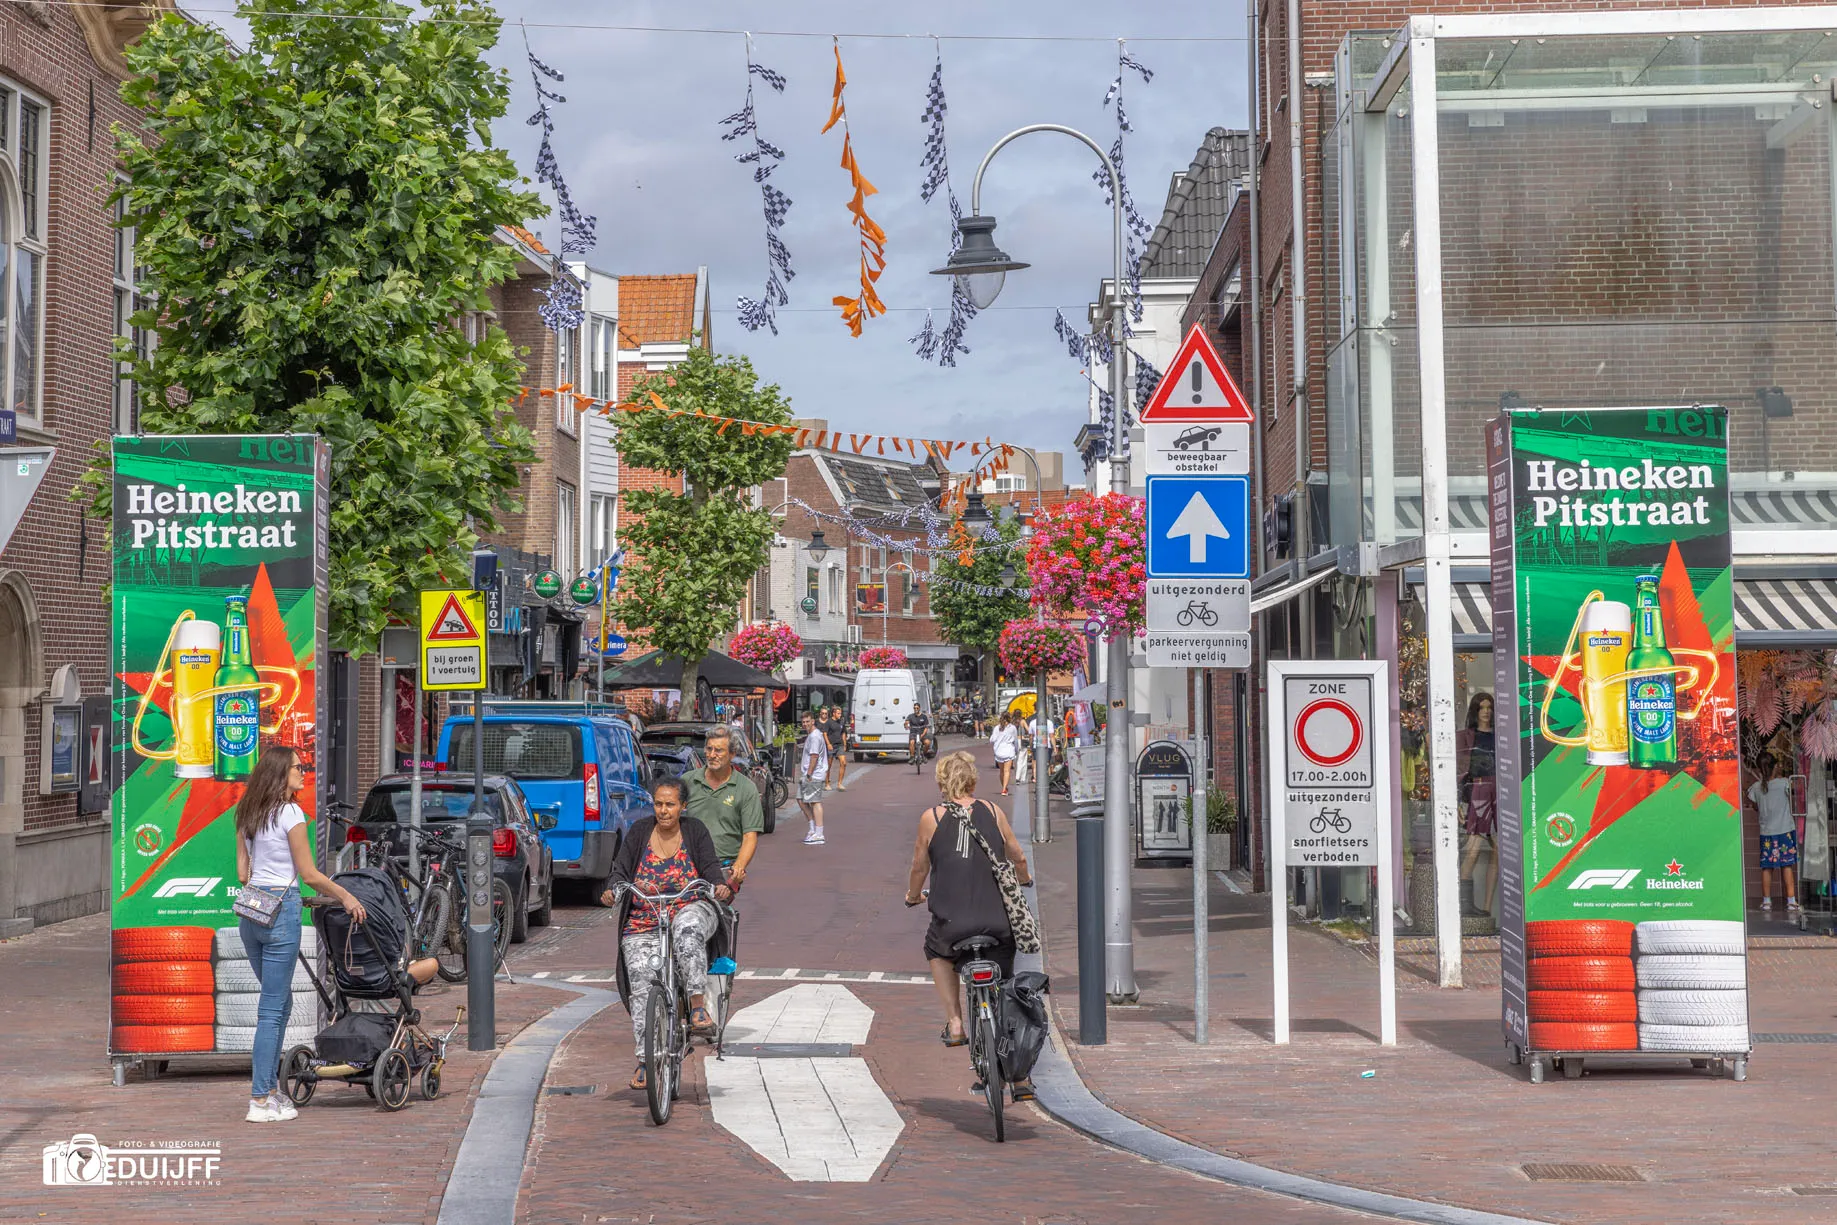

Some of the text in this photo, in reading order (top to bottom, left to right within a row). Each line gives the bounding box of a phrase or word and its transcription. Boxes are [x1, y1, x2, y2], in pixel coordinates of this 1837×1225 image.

[1168, 453, 1227, 462] beweegbaar
[1176, 463, 1218, 472] obstakel
[1527, 459, 1714, 491] Heineken
[126, 484, 302, 514] Heineken
[1533, 495, 1710, 526] Pitstraat
[132, 518, 296, 549] Pitstraat
[1152, 584, 1245, 598] uitgezonderd
[608, 642, 627, 650] rimera
[1150, 637, 1248, 649] parkeervergunning
[434, 655, 474, 665] bij groen
[1171, 651, 1226, 663] niet geldig
[439, 665, 476, 677] voertuig
[1309, 684, 1346, 694] ZONE
[1630, 700, 1674, 710] Heineken
[216, 715, 257, 724] Heineken
[1149, 754, 1180, 762] VLUG
[1292, 771, 1367, 782] 17.00-2.00h
[1293, 837, 1369, 847] snorfietsers
[1303, 852, 1359, 862] verboden
[1566, 869, 1642, 889] F1
[1646, 878, 1704, 889] Heineken
[152, 877, 223, 897] F1
